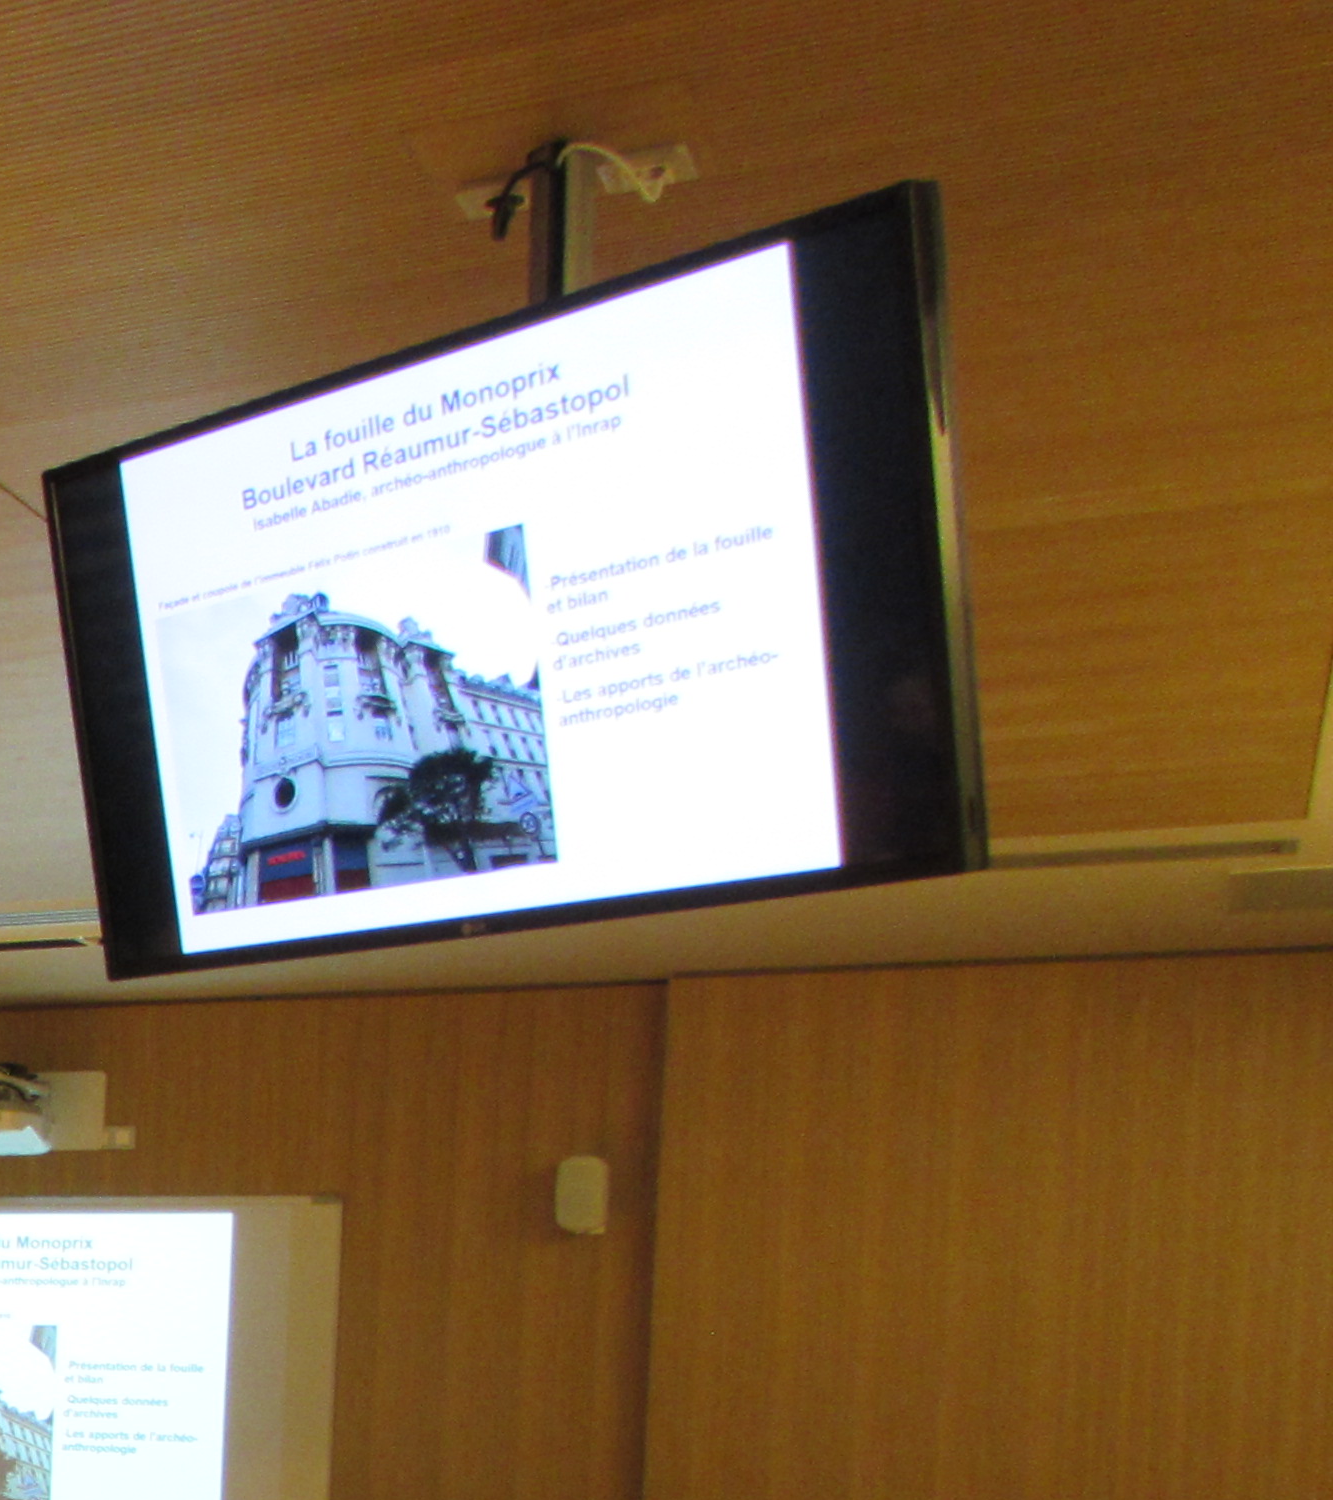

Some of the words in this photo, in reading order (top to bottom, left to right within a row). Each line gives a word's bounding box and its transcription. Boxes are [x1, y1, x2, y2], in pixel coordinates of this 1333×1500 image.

[290, 440, 317, 462] La
[324, 413, 395, 451] fouille
[403, 403, 433, 427] du
[441, 363, 561, 416] Monoprix
[242, 457, 355, 510] Boulevard
[362, 373, 630, 474] Réaumur-Sébastopol
[253, 506, 307, 531] Isabelle
[311, 489, 367, 515] Abadie,
[371, 437, 547, 498] archéo-anthropologue
[552, 431, 561, 446] à
[566, 415, 622, 442] l'Inrap
[665, 546, 687, 563] de
[693, 541, 709, 557] la
[715, 526, 773, 552] fouille
[547, 598, 562, 614] et
[567, 590, 608, 610] bilan
[643, 601, 721, 628] données
[553, 643, 641, 670] d'archives
[597, 673, 664, 699] apports
[669, 666, 691, 682] de
[696, 652, 779, 678] l'archéo-
[559, 691, 679, 727] anthropologie
[17, 1236, 93, 1252] Monoprix
[64, 1375, 74, 1384] et
[78, 1374, 103, 1384] bilan
[141, 1362, 154, 1371] de
[157, 1362, 166, 1372] la
[170, 1363, 204, 1373] fouille
[122, 1396, 168, 1407] données
[62, 1442, 137, 1456] anthropologie
[89, 1431, 130, 1440] apports
[133, 1431, 146, 1441] de
